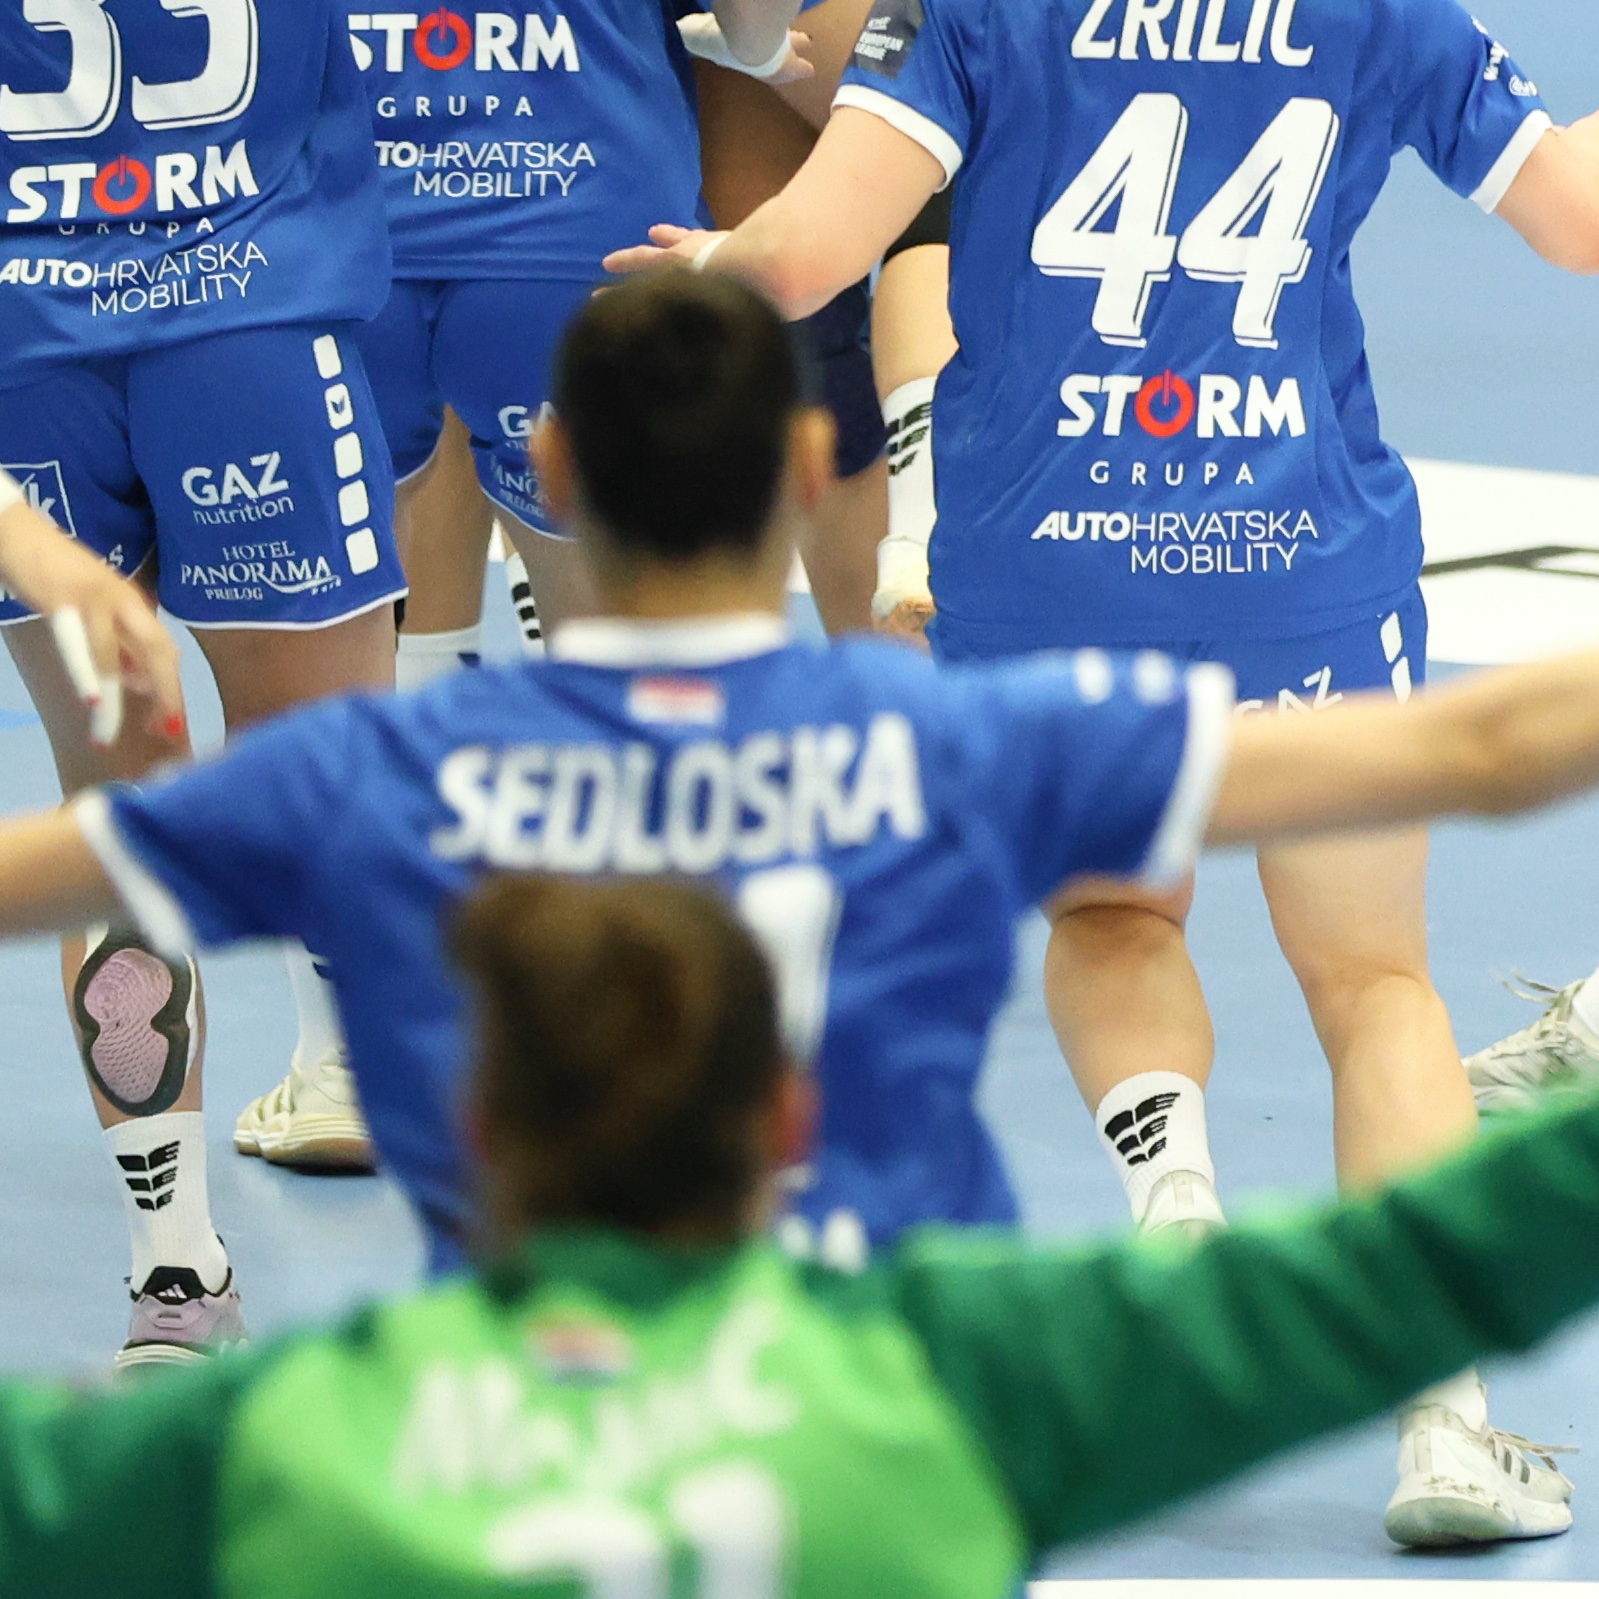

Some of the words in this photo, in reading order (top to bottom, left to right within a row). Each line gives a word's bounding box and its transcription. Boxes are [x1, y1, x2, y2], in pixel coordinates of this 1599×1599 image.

[348, 5, 581, 73] STORM
[377, 95, 534, 118] GRUPA
[374, 140, 596, 169] TOHRVATSKA
[6, 139, 260, 224] STORM
[413, 170, 577, 197] MOBILITY
[1030, 92, 1341, 350] 44
[91, 270, 252, 317] MOBILITY
[1056, 369, 1307, 438] STORM
[181, 451, 290, 506] GAZ
[1089, 461, 1255, 486] GRUPA
[192, 496, 295, 525] nutrition
[1030, 509, 1320, 543] AUTOHRVATSKA
[221, 540, 296, 561] HOTEL
[1131, 542, 1300, 574] MOBILITY
[181, 556, 342, 594] PANORAMA
[431, 713, 927, 874] SEDLOSKA
